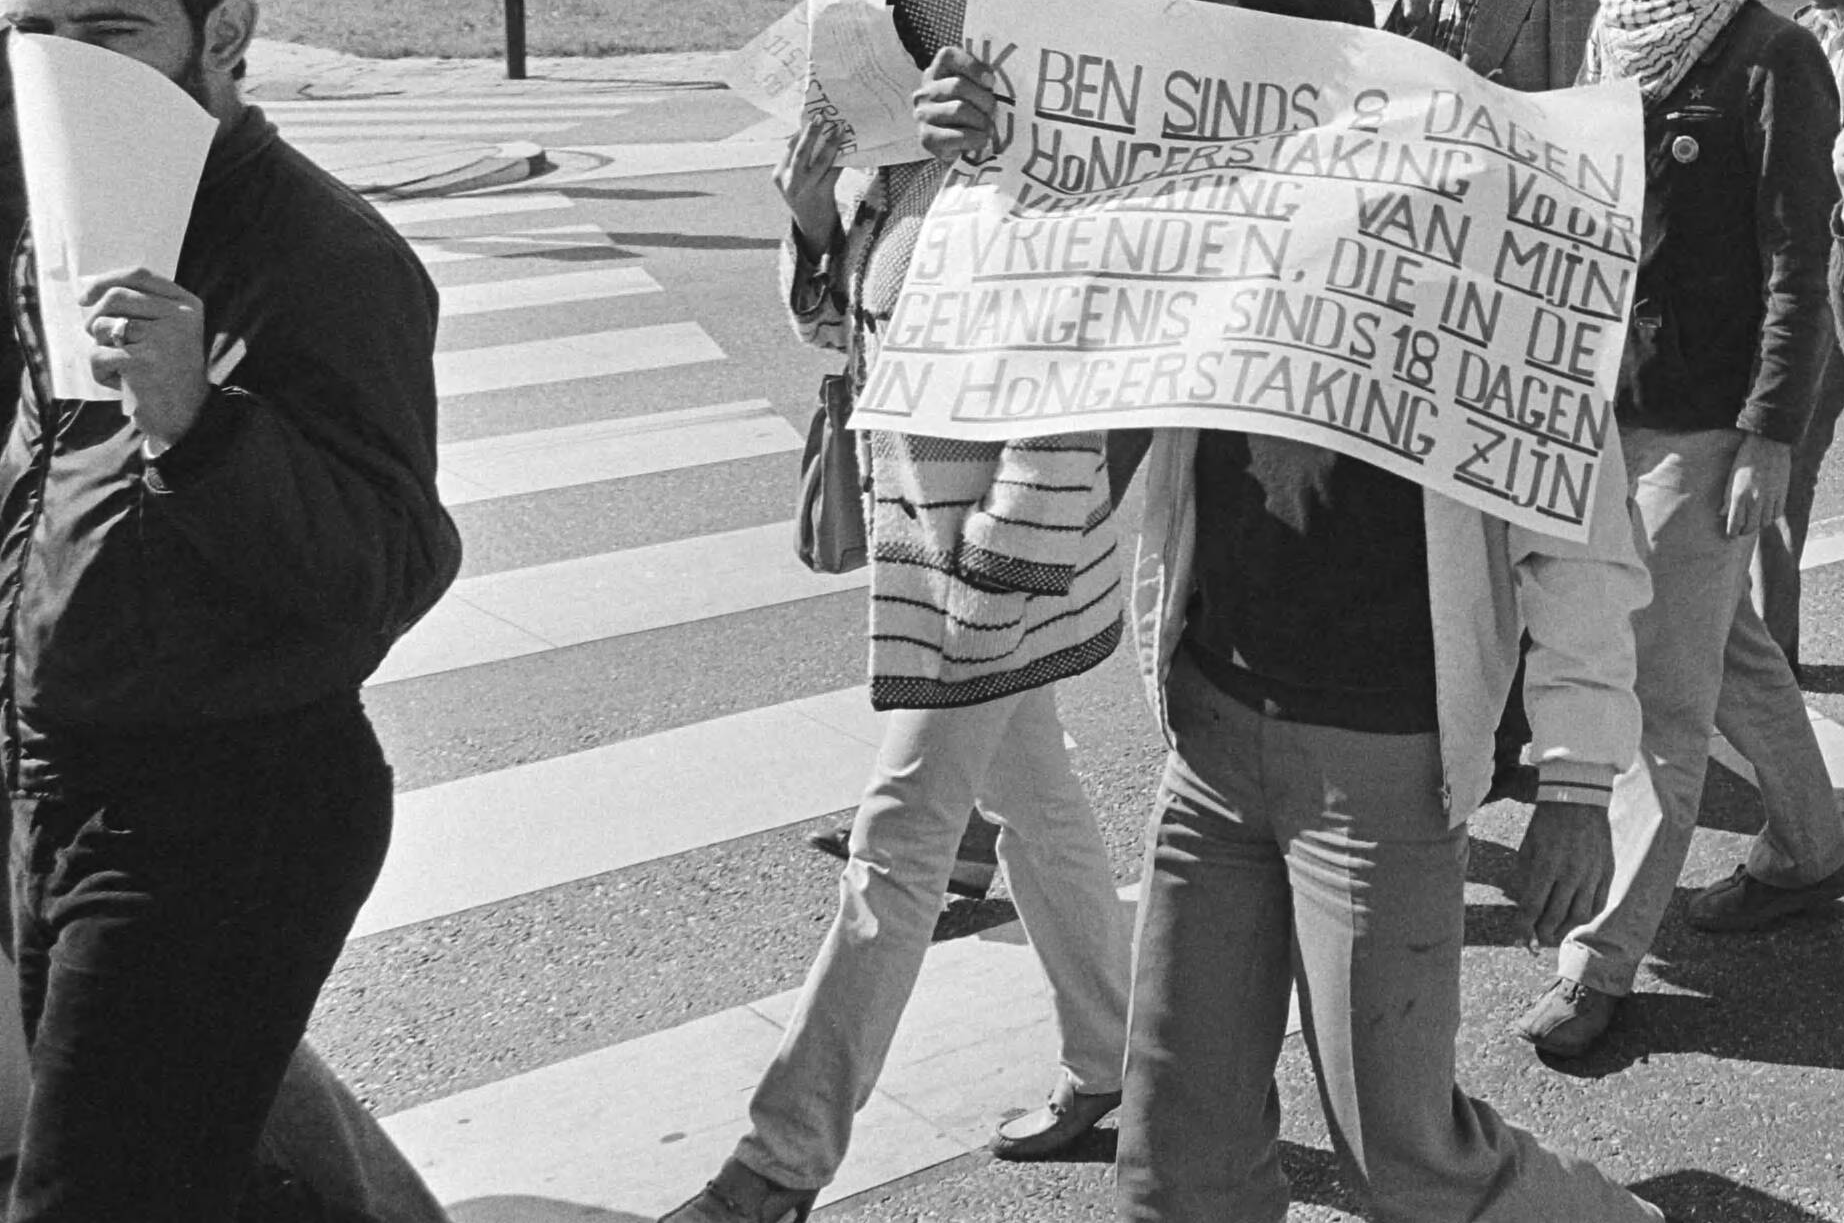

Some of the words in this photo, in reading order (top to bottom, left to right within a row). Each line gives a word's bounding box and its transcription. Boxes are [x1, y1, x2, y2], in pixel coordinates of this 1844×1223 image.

[1033, 47, 1144, 127] BEN
[1164, 68, 1322, 138] SINDS
[1424, 88, 1625, 204] DAGEN
[1326, 237, 1424, 313] DIE
[1441, 274, 1503, 345] IN
[1525, 306, 1603, 378] DE
[1355, 187, 1472, 265] VAN
[1493, 228, 1631, 321] MIJN
[859, 359, 935, 412] IN
[1455, 417, 1594, 522] ZIJN
[887, 284, 1198, 347] GEVANGENIS
[1224, 286, 1382, 360] SINDS
[1393, 324, 1440, 387] 18
[1455, 349, 1613, 451] DAGEN
